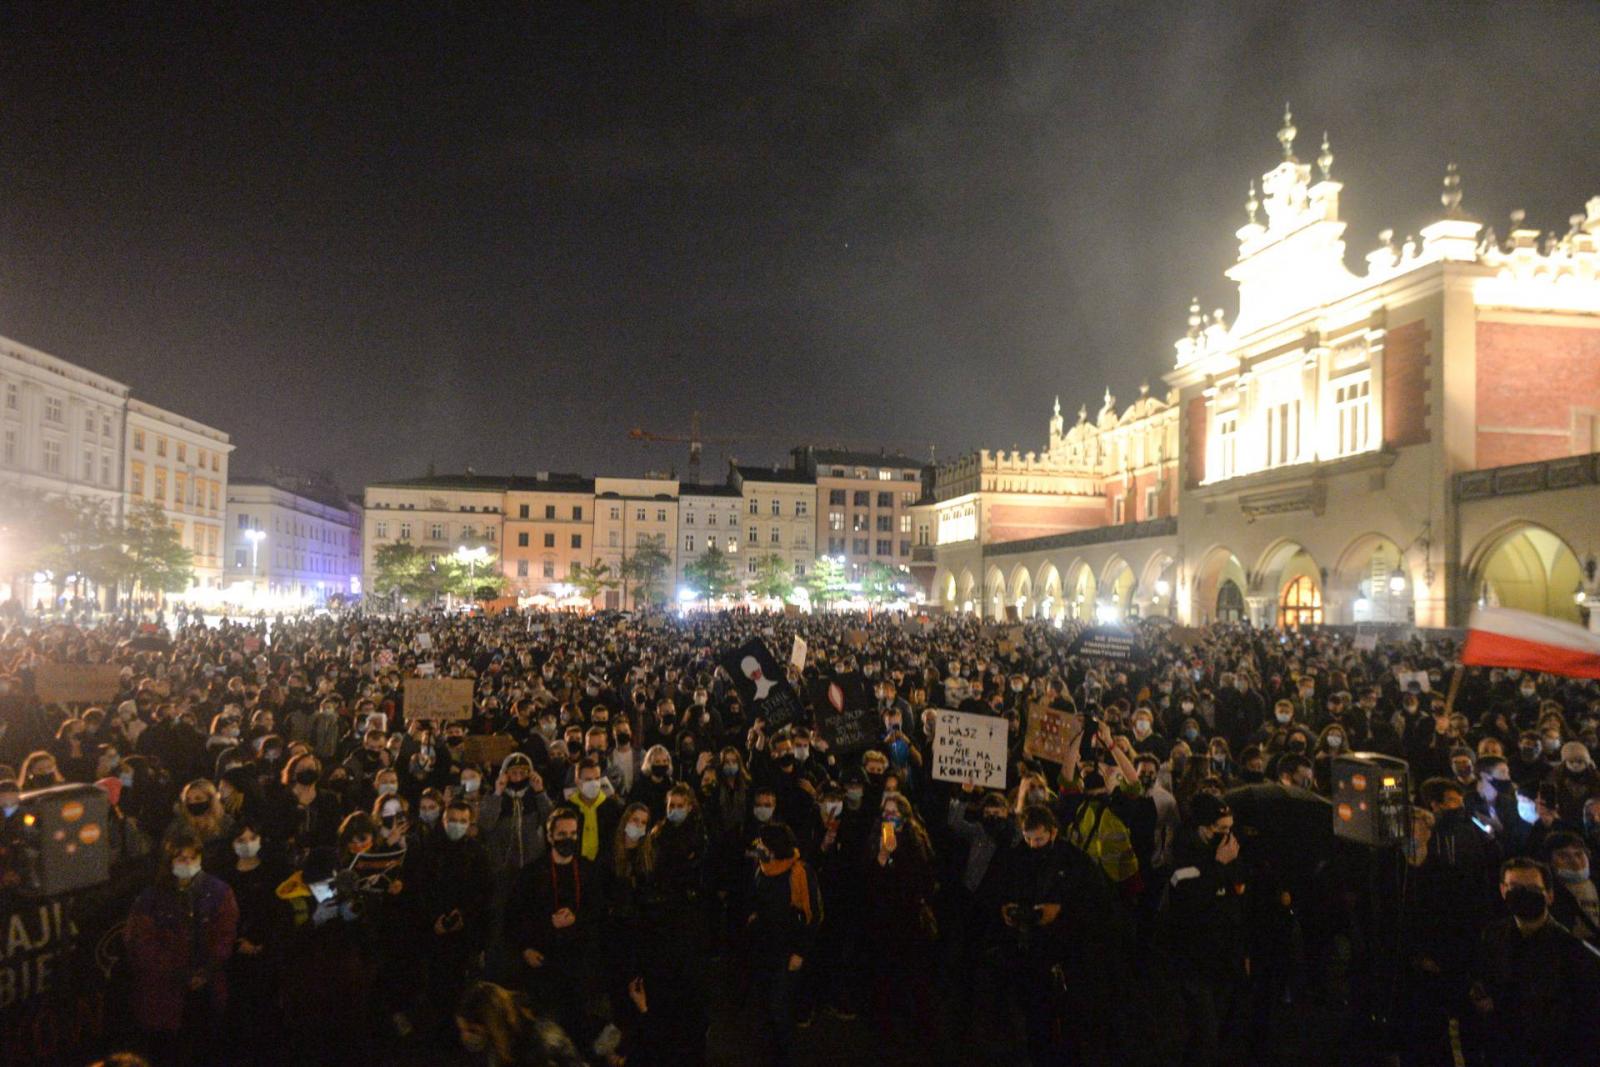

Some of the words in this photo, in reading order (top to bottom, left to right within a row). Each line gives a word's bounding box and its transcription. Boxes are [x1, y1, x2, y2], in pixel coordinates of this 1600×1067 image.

[942, 715, 960, 724] CZY
[948, 725, 977, 739] WASZ
[953, 748, 970, 757] NIE
[976, 751, 990, 760] MA
[984, 761, 1002, 772] DLA
